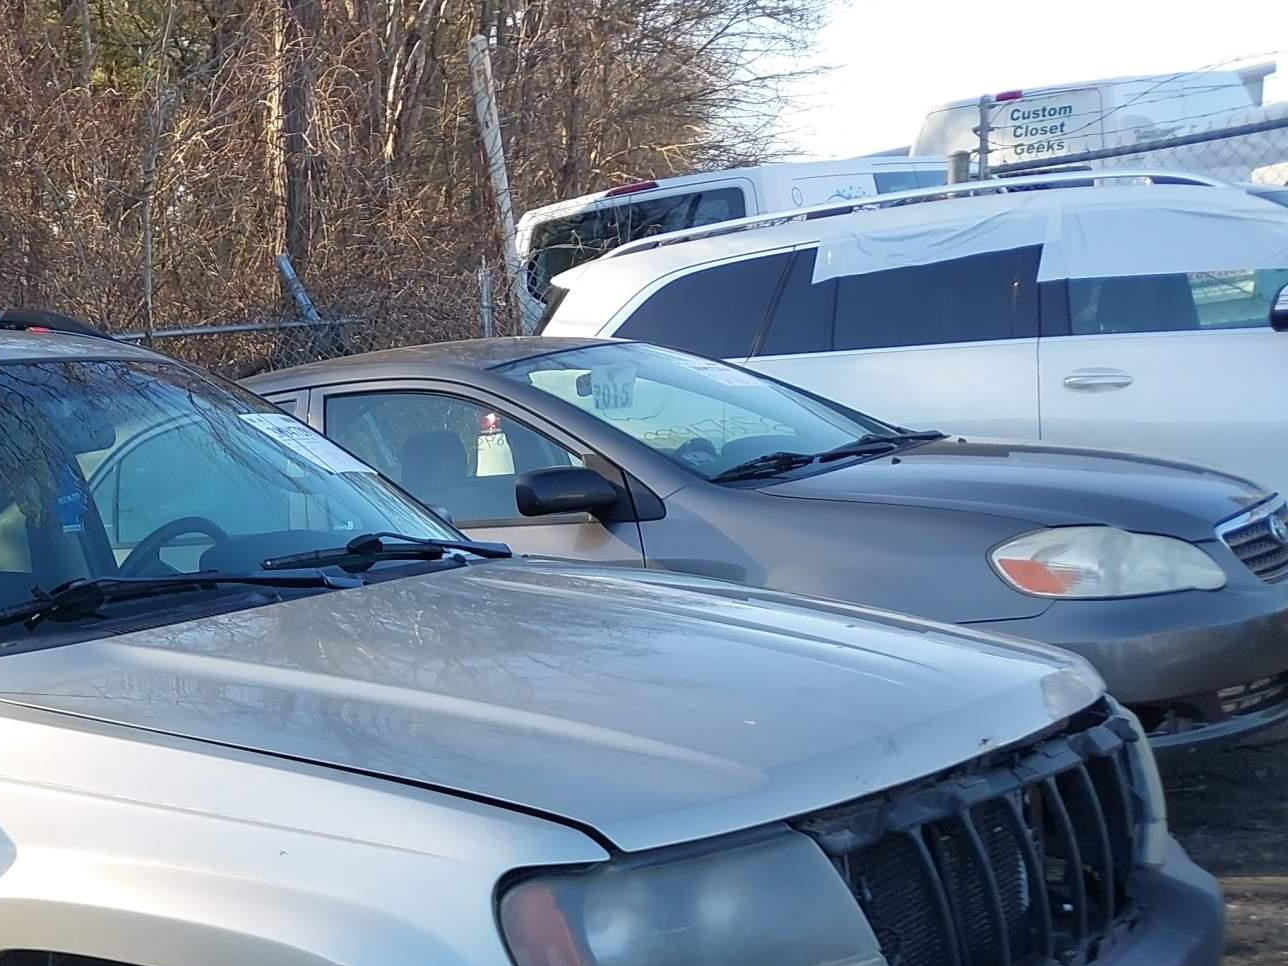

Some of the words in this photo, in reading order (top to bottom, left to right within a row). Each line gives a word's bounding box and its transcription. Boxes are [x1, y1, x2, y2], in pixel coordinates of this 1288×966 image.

[1010, 105, 1073, 121] Custom
[1013, 122, 1065, 138] Closet
[1013, 141, 1064, 156] Geeks
